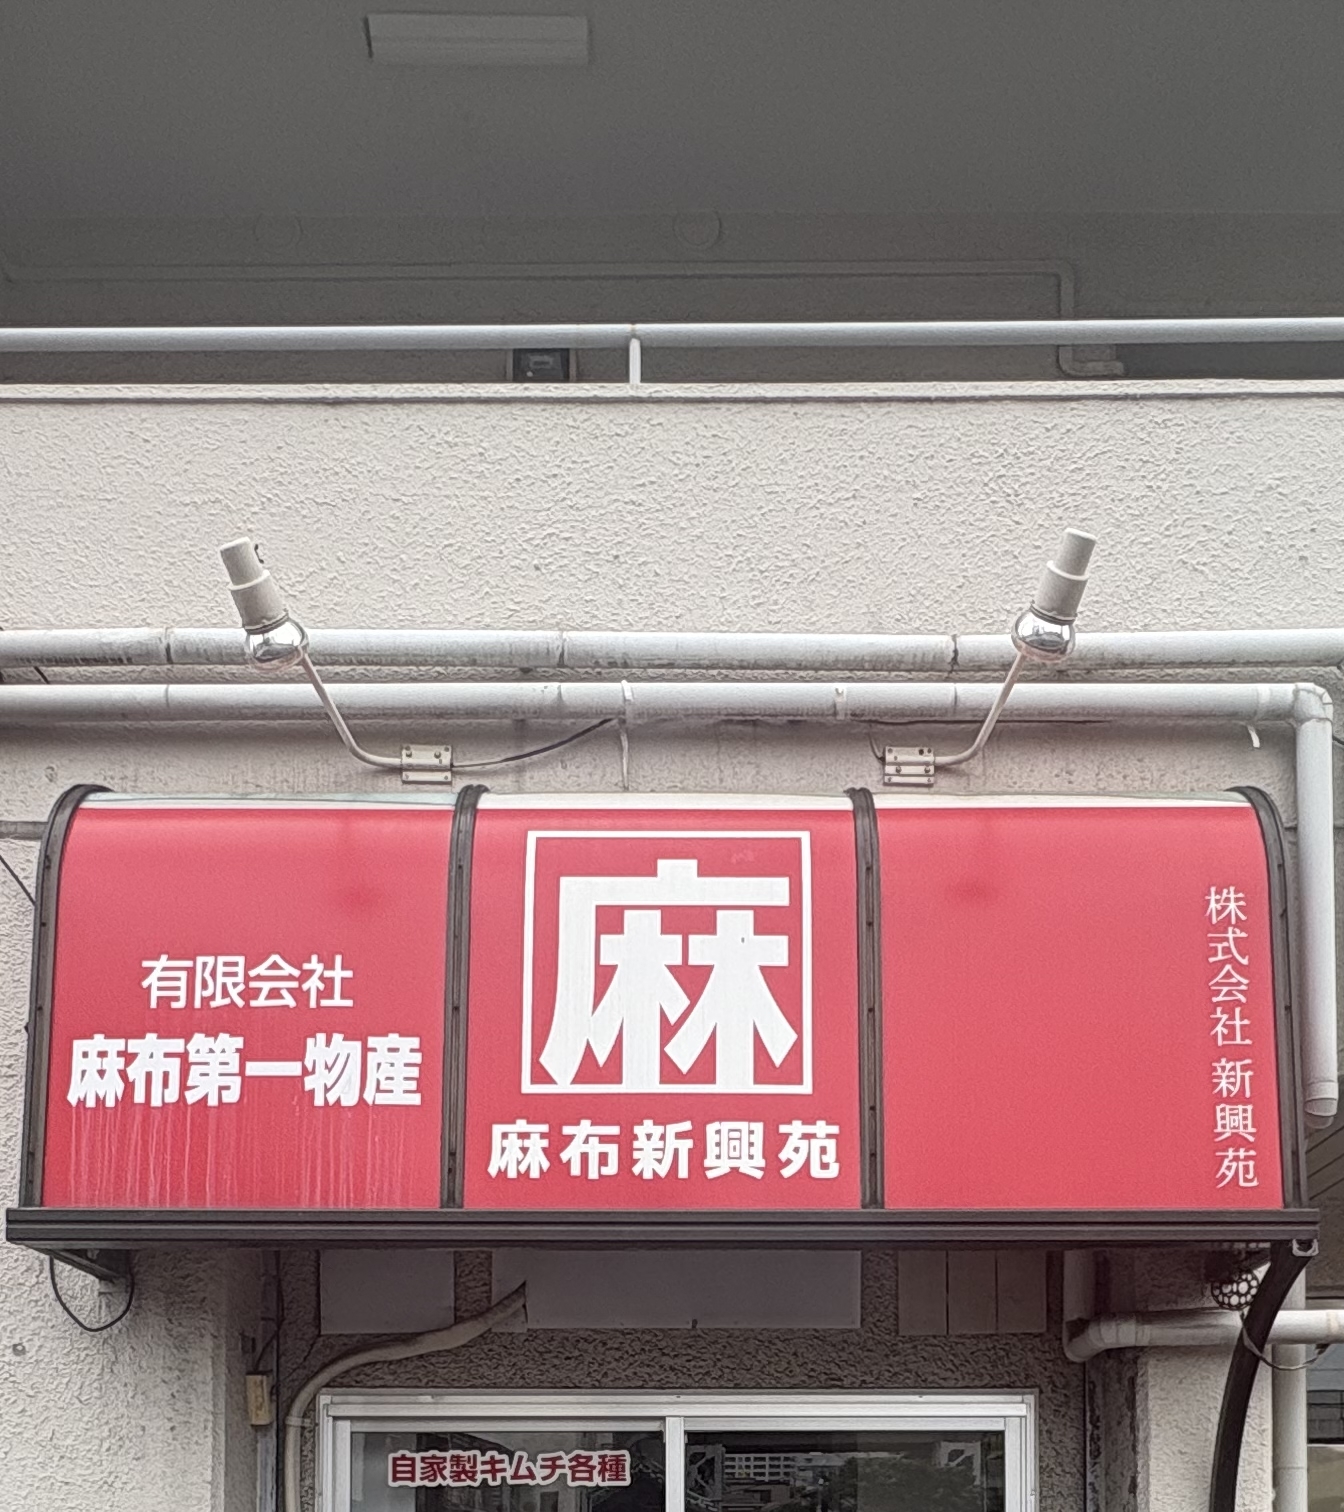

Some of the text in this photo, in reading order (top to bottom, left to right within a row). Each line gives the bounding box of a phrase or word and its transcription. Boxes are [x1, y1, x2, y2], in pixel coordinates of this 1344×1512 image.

[141, 954, 354, 1009] 有限会社
[539, 858, 798, 1087] 麻
[67, 1032, 422, 1107] 麻布第一物産
[487, 1118, 841, 1181] 麻布新興苑
[389, 1451, 630, 1485] 自家製キムチ各種
